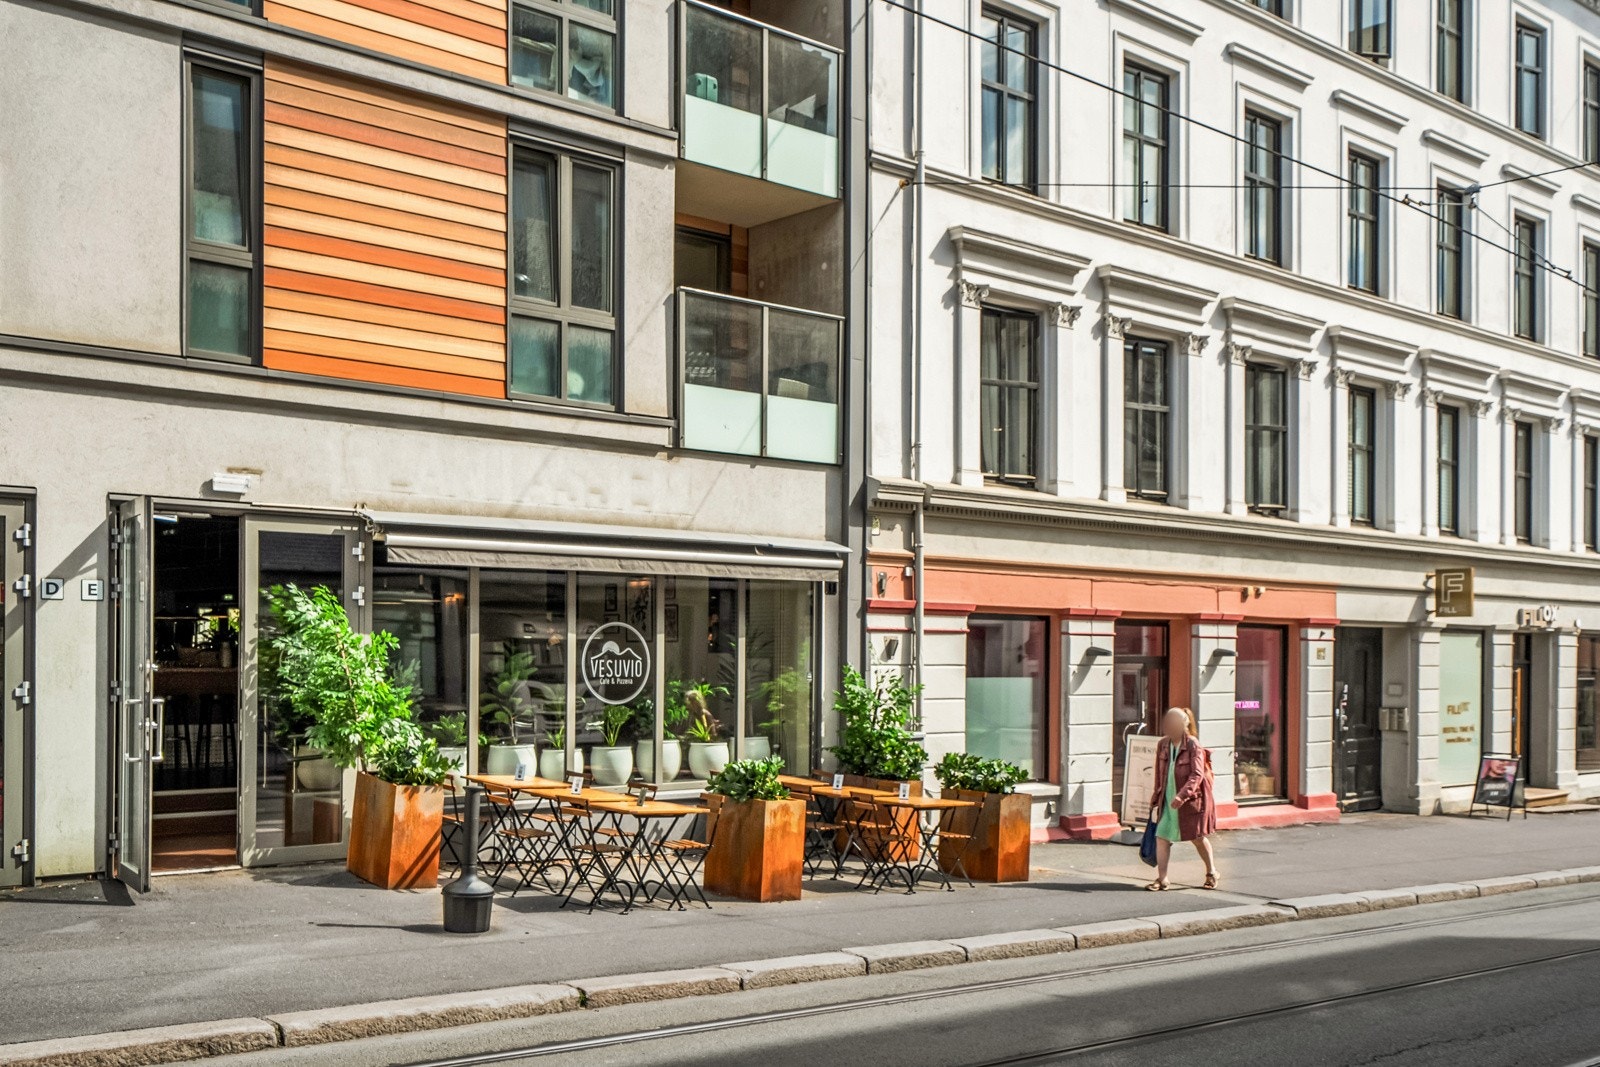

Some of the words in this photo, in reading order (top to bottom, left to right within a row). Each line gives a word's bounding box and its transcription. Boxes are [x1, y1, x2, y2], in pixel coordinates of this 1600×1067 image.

[45, 582, 59, 595] D
[88, 583, 97, 596] E
[1441, 572, 1465, 603] F
[590, 659, 642, 678] VESUVIO
[611, 677, 616, 685] &
[616, 677, 634, 685] Pizzeria
